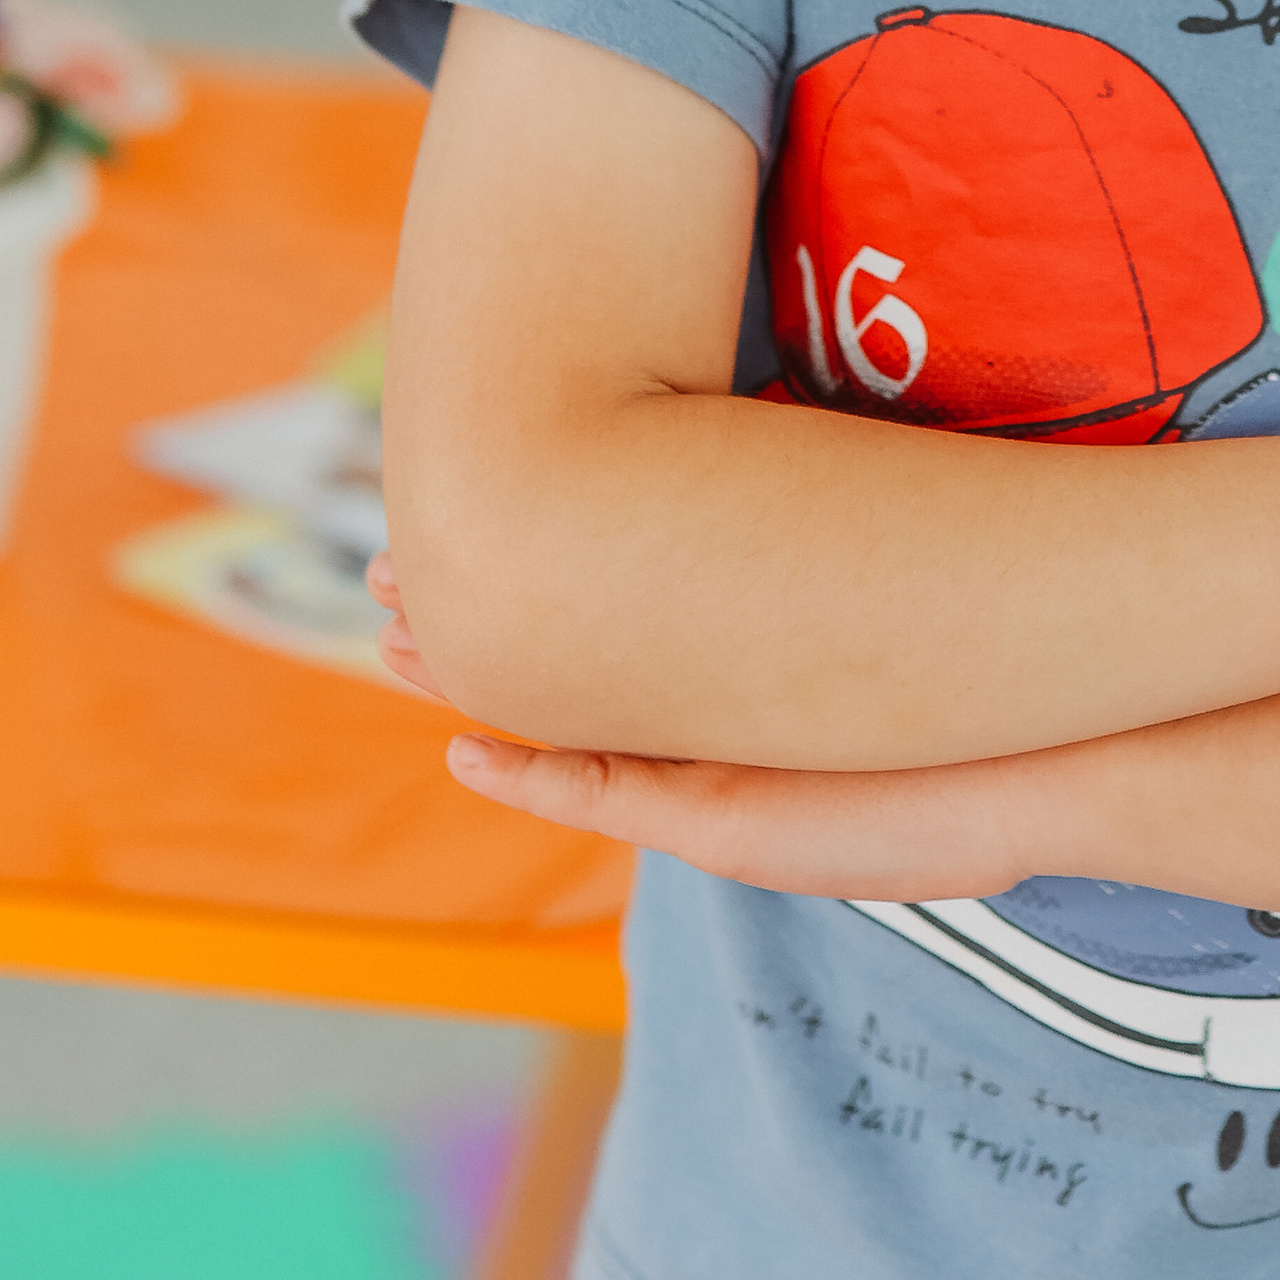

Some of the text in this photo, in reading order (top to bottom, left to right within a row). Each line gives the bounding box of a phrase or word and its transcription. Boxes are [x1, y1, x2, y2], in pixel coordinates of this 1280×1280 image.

[796, 244, 929, 400] 16
[840, 1073, 1088, 1208] fail trying
